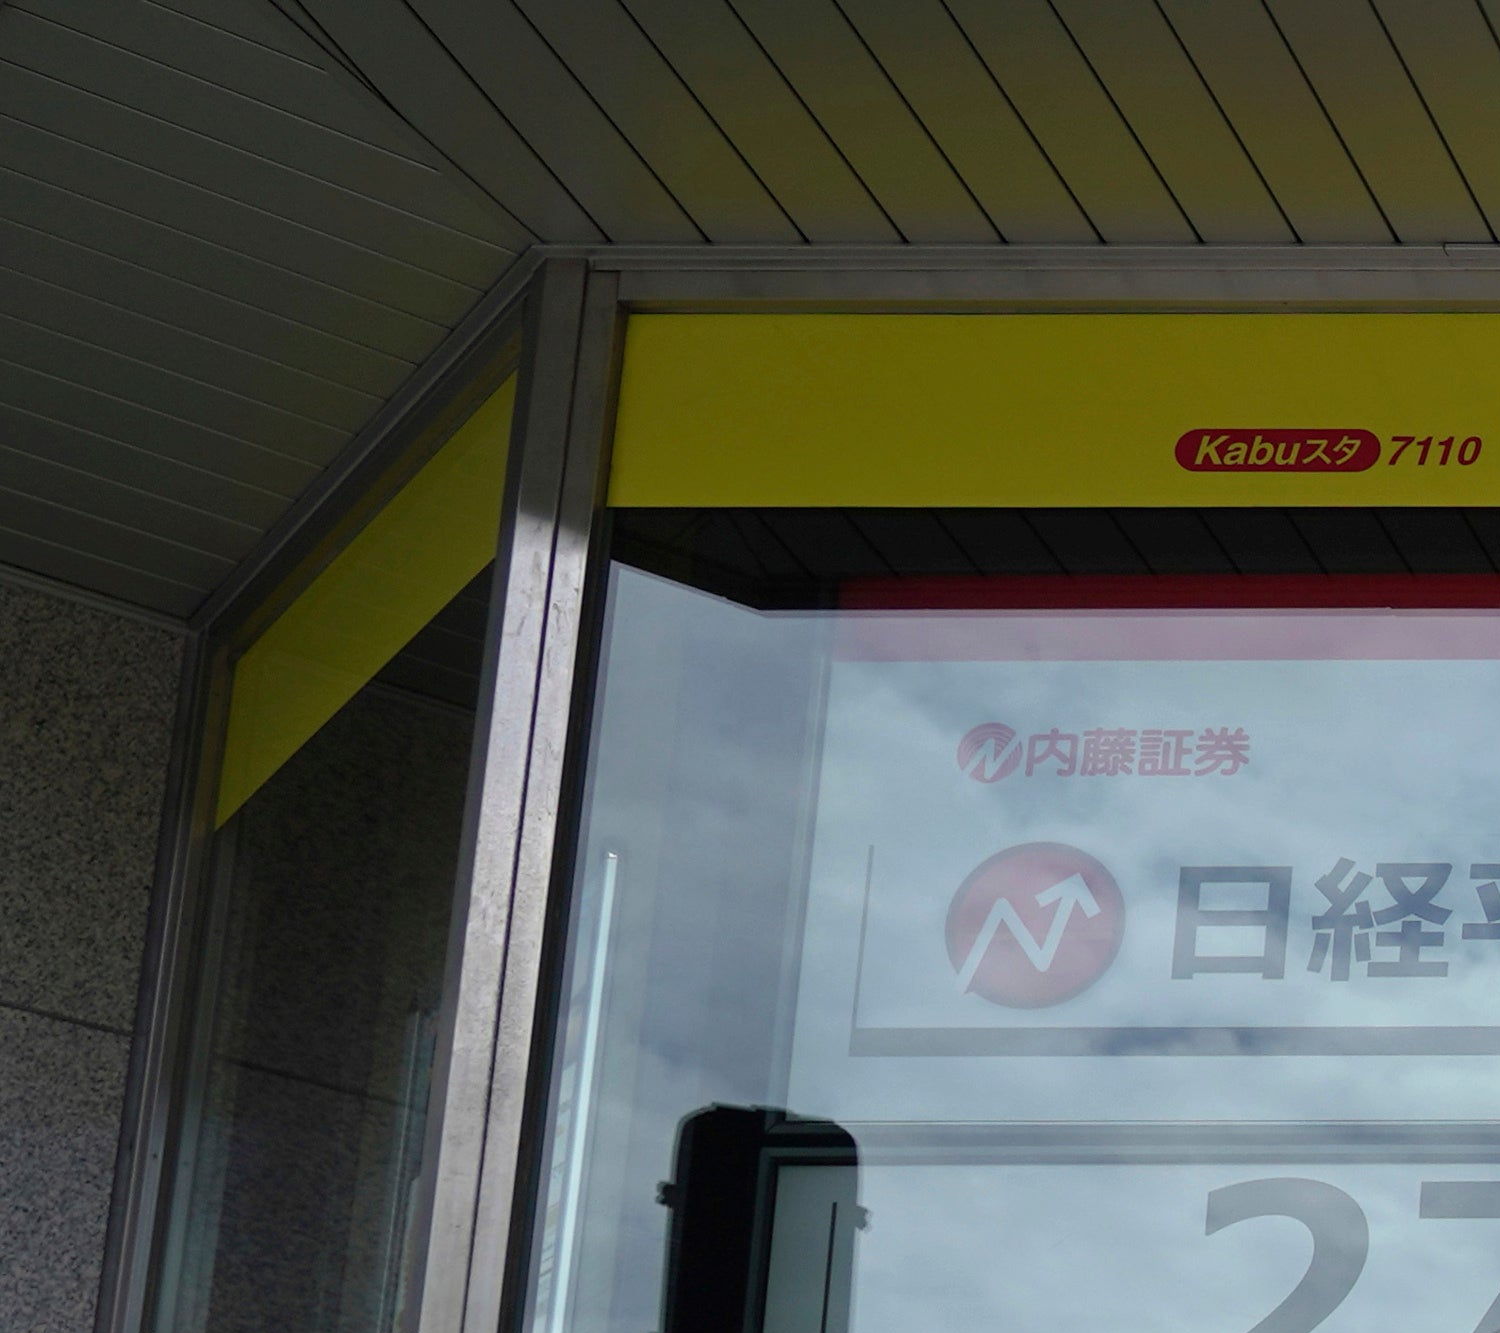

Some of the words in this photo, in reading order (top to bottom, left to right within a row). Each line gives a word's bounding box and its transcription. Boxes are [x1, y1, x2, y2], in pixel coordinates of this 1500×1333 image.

[1195, 435, 1361, 465] Kabuスタ
[1388, 436, 1482, 466] 7110
[1025, 726, 1250, 777] 内藤証券
